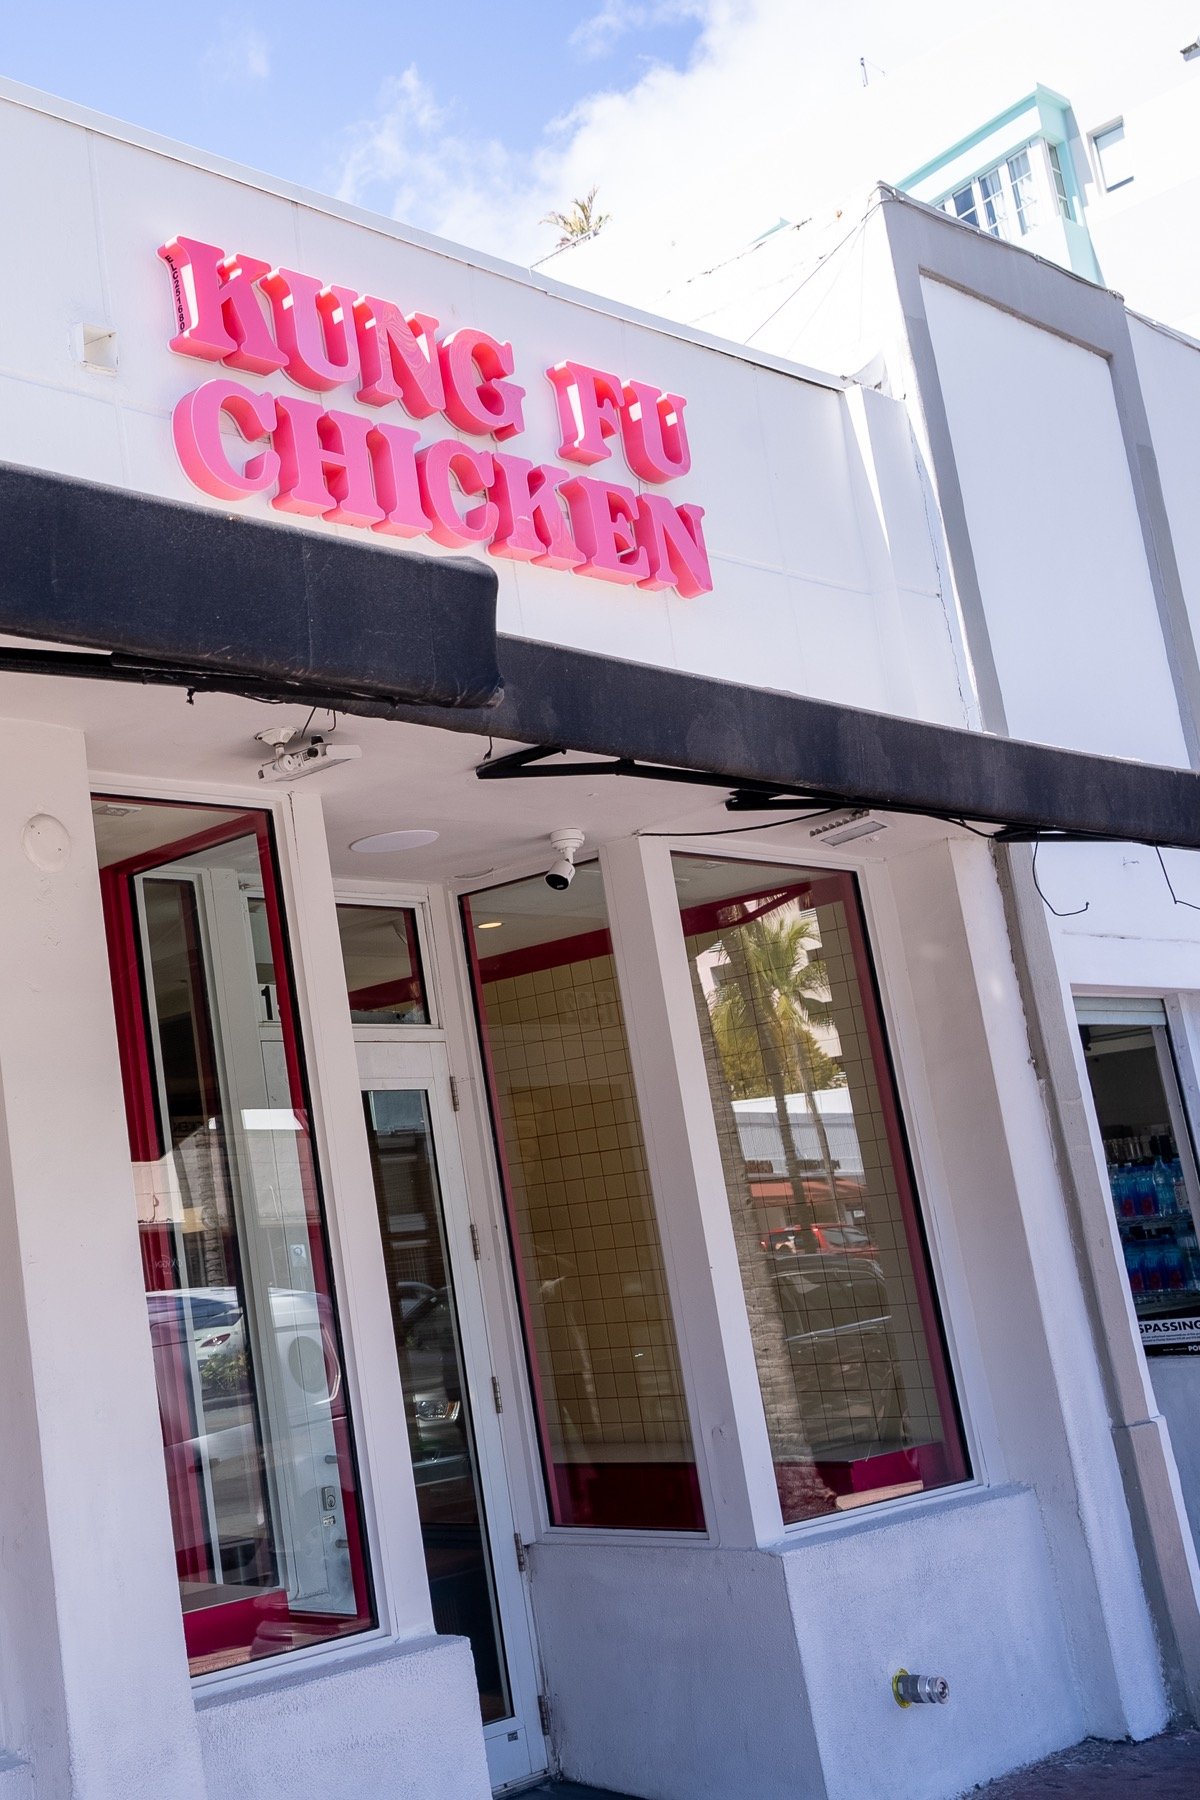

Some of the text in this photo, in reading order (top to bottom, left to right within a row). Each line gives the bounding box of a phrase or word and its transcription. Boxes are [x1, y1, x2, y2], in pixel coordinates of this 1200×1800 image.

[157, 235, 692, 485] KUNG FU
[172, 378, 714, 600] CHICKEN
